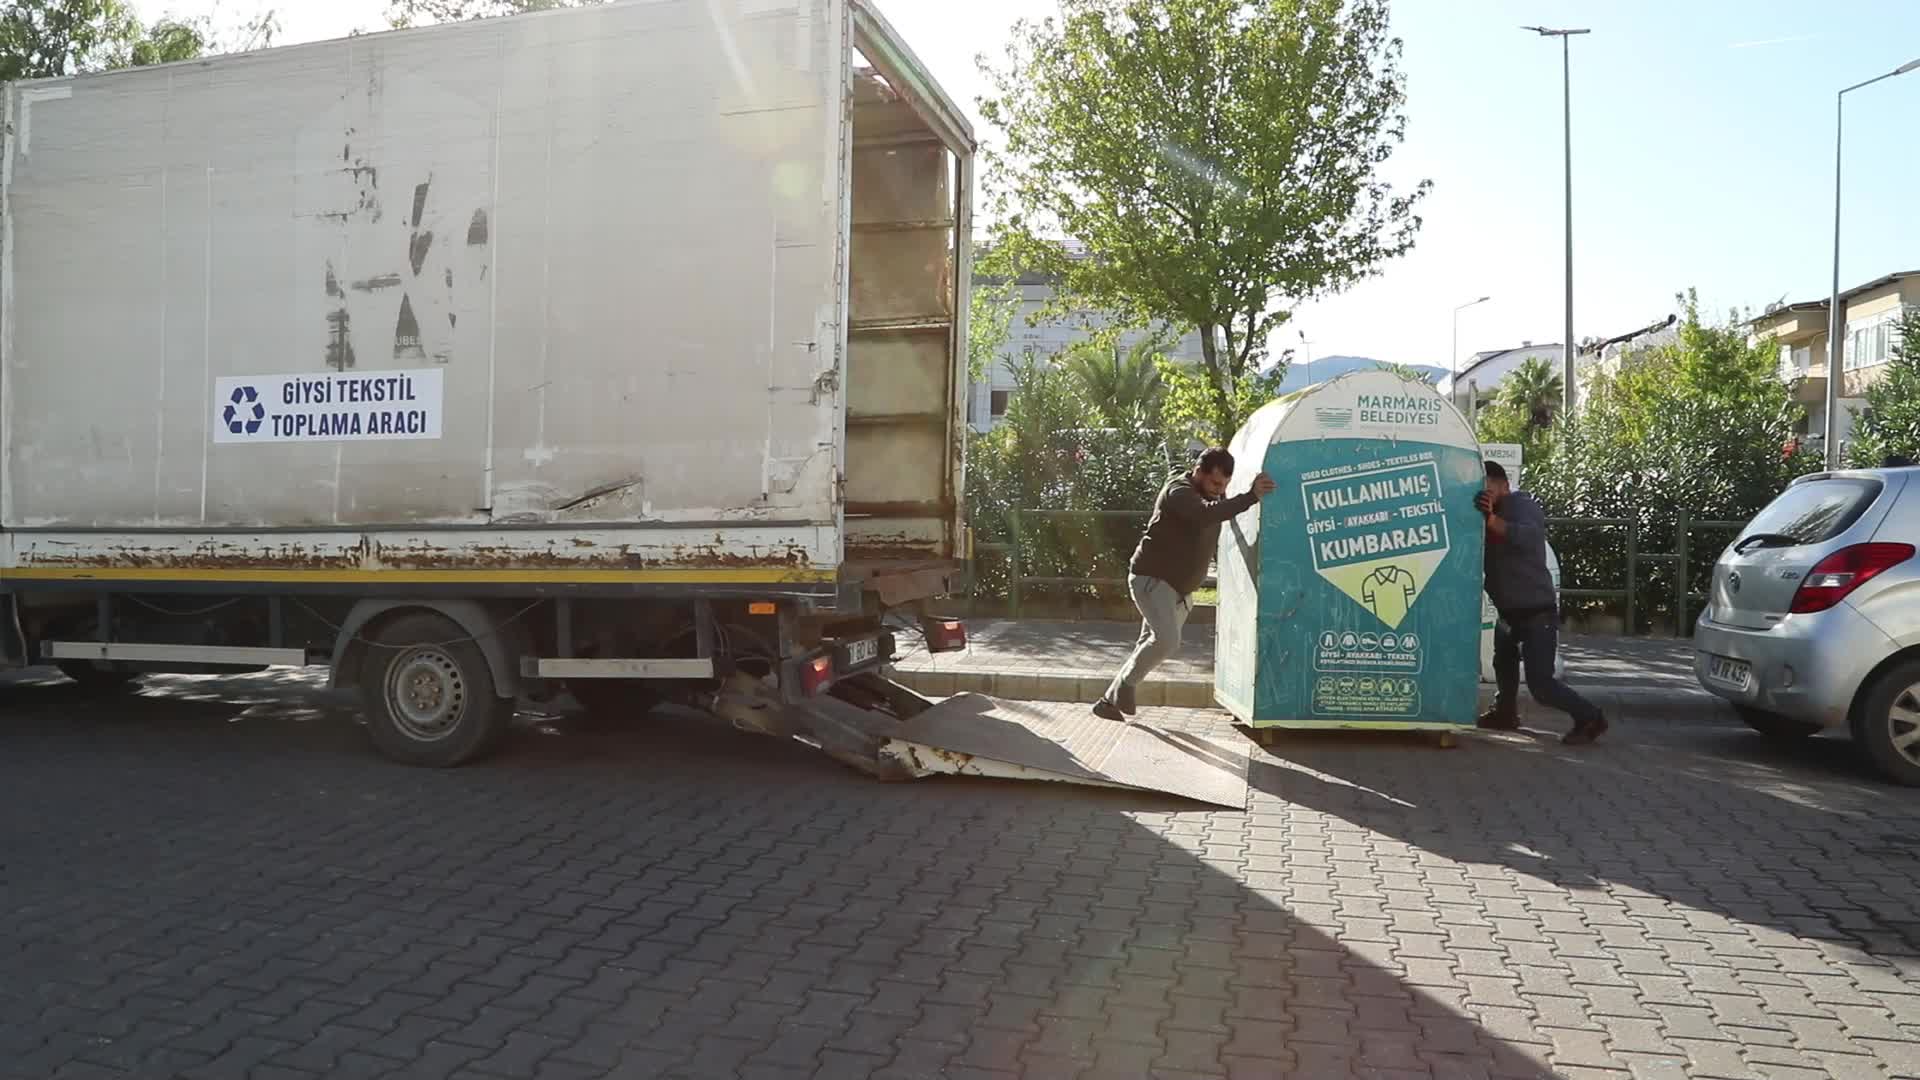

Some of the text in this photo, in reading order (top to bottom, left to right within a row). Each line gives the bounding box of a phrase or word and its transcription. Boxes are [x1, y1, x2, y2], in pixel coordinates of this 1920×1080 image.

[283, 373, 415, 404] GİYSİ TEKSTİL
[272, 411, 426, 437] TOPLAMA ARACI
[1360, 410, 1439, 424] BELEDİYESİ
[1301, 470, 1320, 480] USED
[1321, 465, 1352, 477] CLOTHES
[1358, 460, 1380, 471] SHOES
[1385, 454, 1418, 466] TEXTILES
[1312, 474, 1431, 511] KULLANILMIŞ
[1306, 516, 1336, 535] GİYSİ
[1399, 499, 1445, 519] TEKSTİL
[1320, 523, 1438, 561] KUMBARASI
